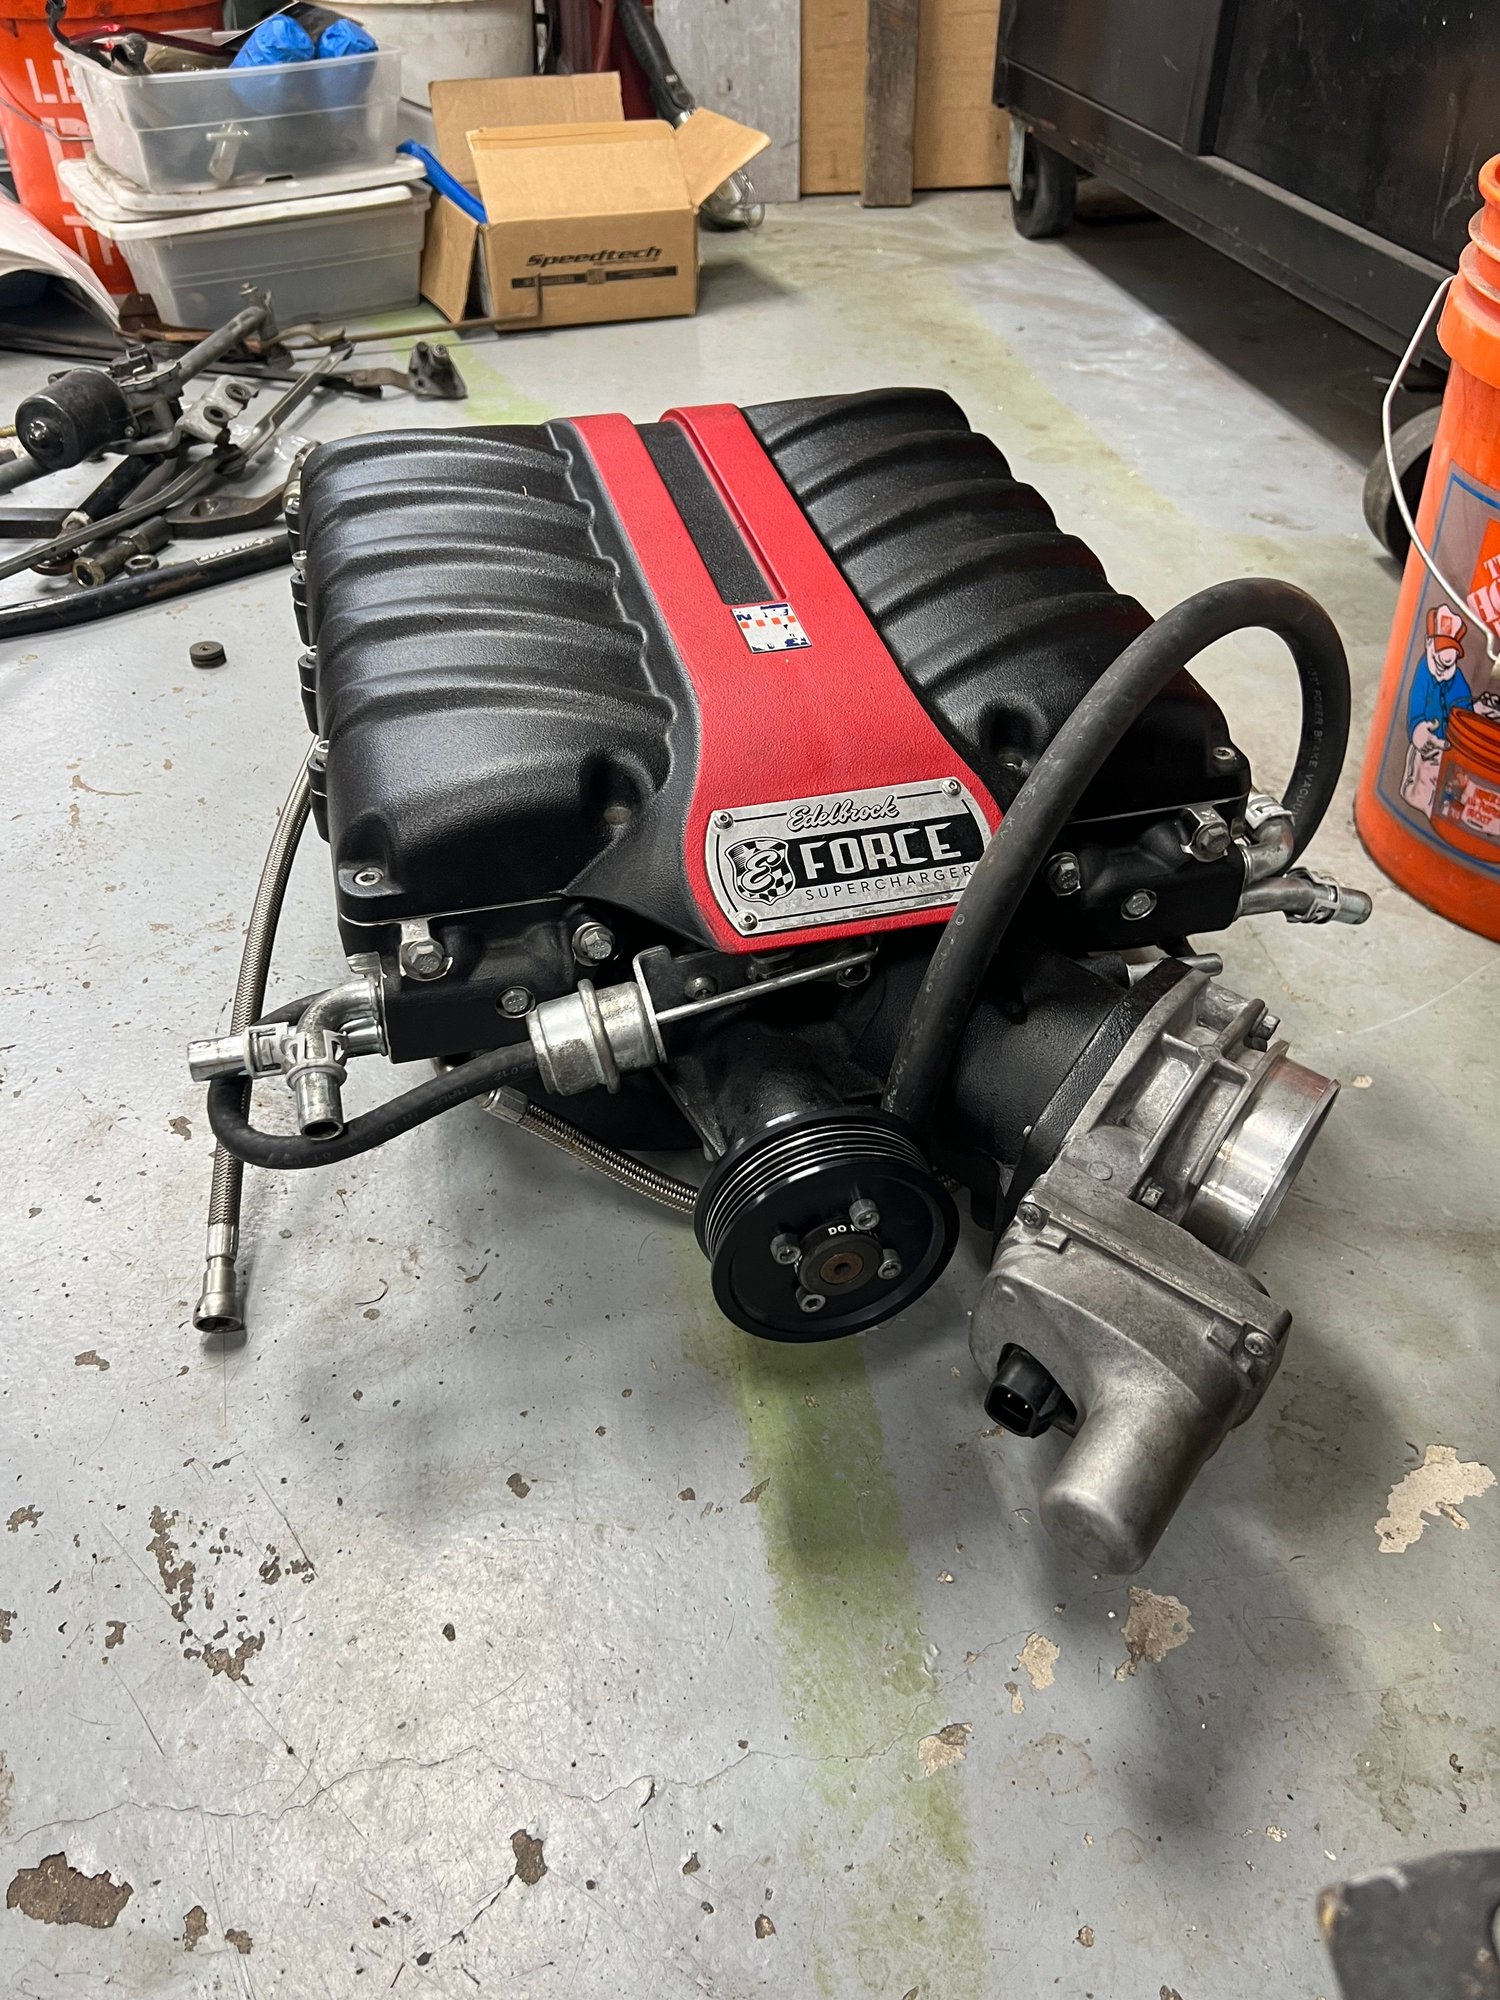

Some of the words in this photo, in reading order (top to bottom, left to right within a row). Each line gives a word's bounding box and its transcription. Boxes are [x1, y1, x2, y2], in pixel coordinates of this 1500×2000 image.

[526, 245, 663, 268] Speedtech
[786, 795, 900, 832] Edelbrock
[799, 822, 962, 881] FORCE
[805, 864, 974, 901] SUPERCHARGER
[828, 1224, 847, 1236] DO
